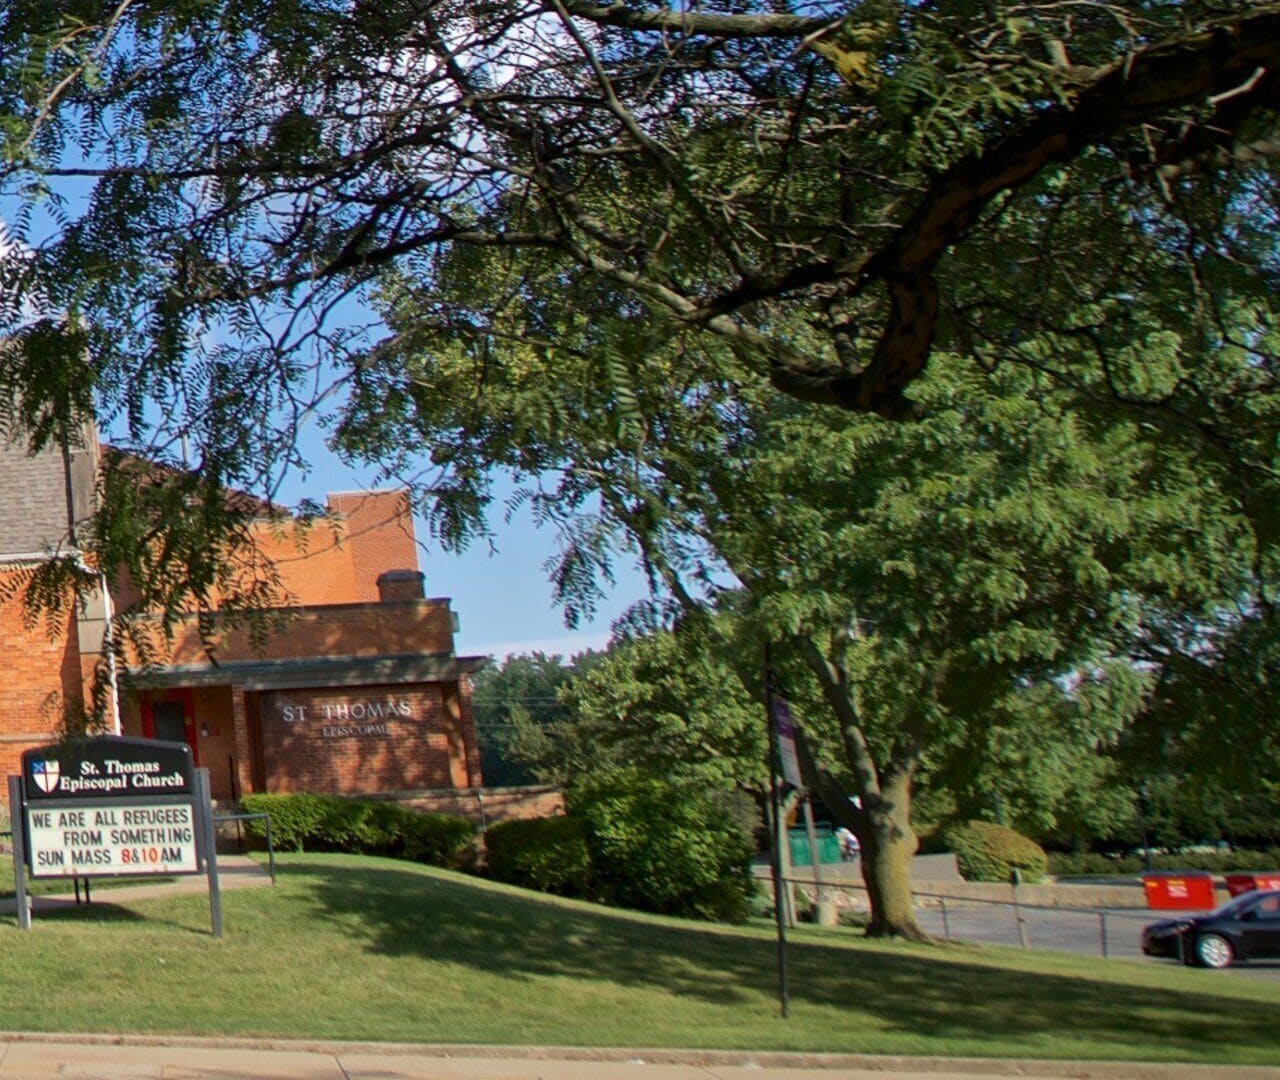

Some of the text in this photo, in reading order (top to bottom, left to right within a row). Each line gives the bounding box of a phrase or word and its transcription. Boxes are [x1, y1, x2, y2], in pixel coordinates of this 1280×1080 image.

[283, 700, 411, 721] ST THOMAS
[323, 724, 389, 737] EPISCOPAL
[80, 759, 160, 775] St. Thomas
[60, 772, 184, 792] Episcopal Church
[32, 808, 188, 828] WE ARE ALL REFUGEES
[63, 828, 192, 846] FROM SOMETHING
[37, 849, 64, 865] SUN
[71, 849, 111, 864] MASS
